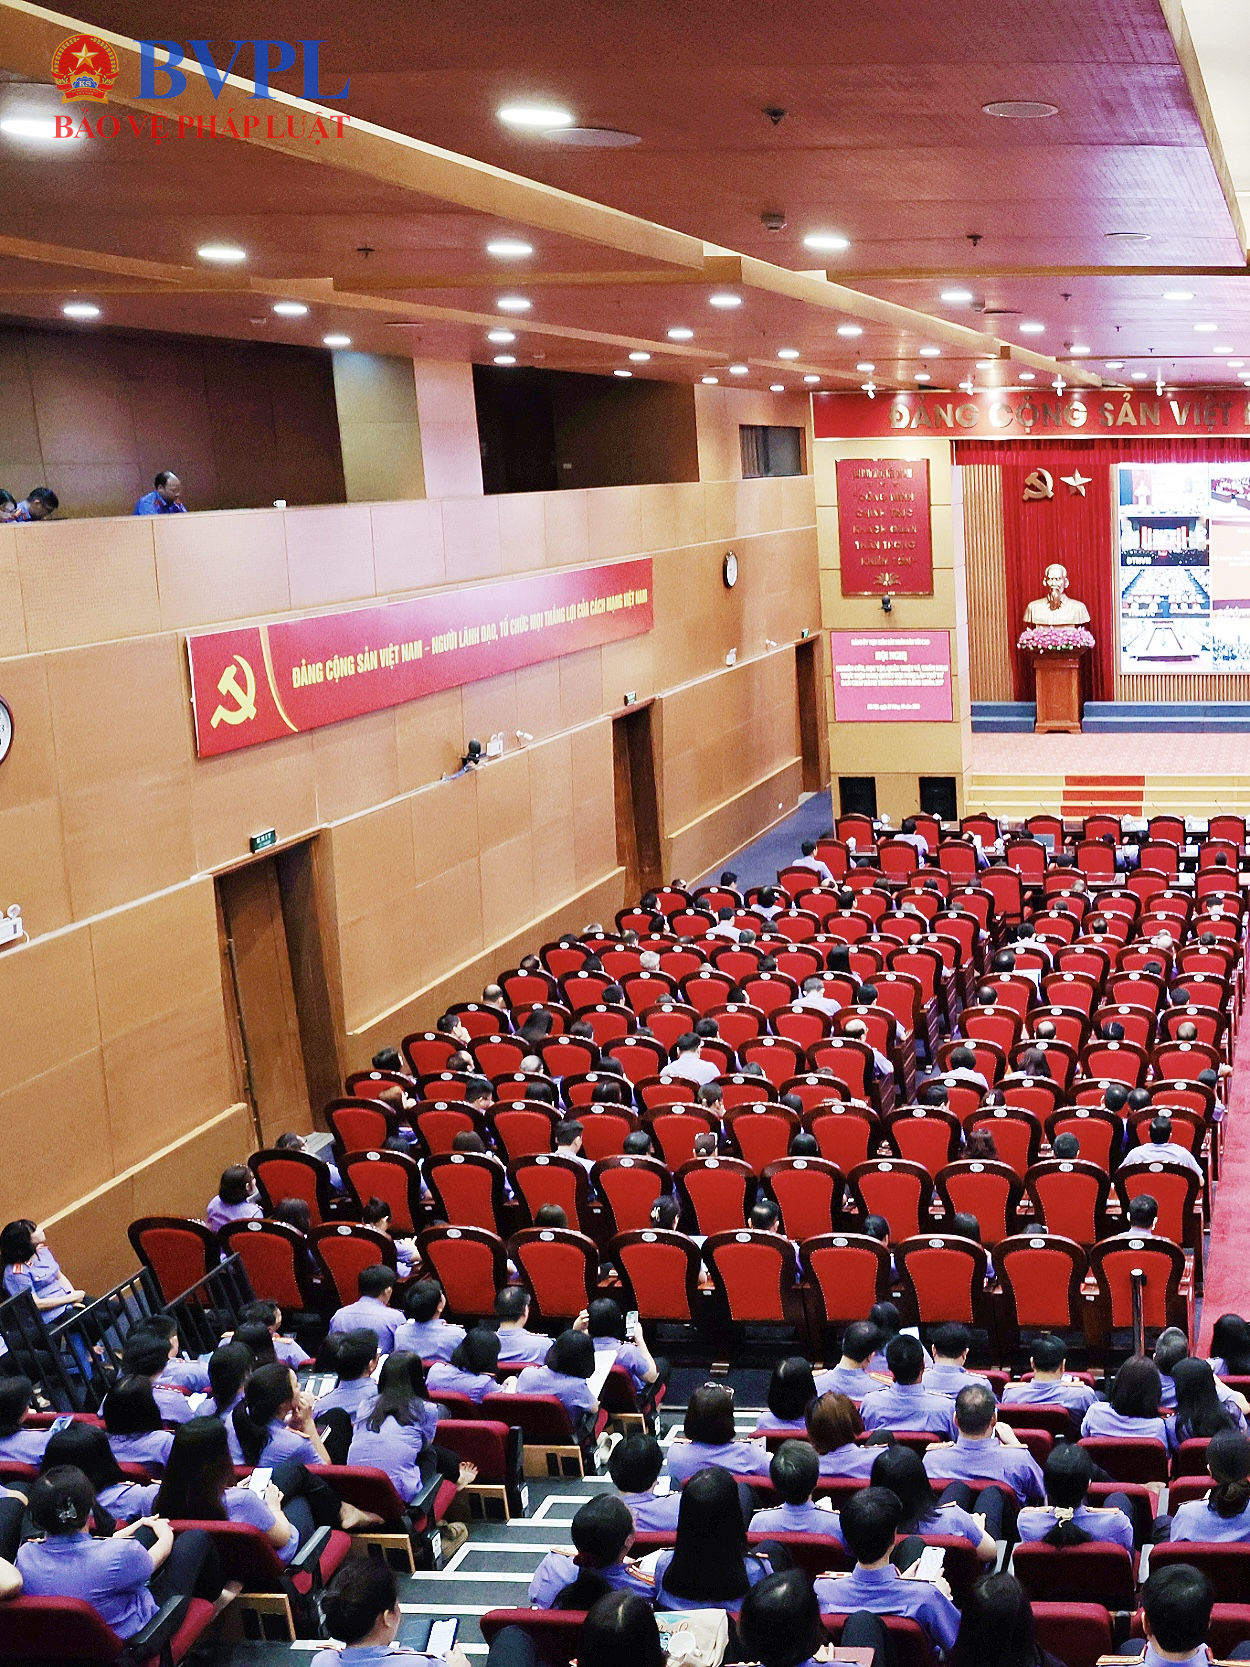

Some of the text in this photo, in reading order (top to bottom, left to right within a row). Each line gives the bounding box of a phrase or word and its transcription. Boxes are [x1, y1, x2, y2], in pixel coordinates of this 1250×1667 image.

[890, 396, 979, 429] ĐẢNG
[988, 395, 1088, 434] CỘNG
[1098, 393, 1161, 429] SẢN
[1168, 394, 1232, 432] VIỆT
[292, 658, 324, 688] ĐẢNG
[325, 654, 355, 683] CỘNG
[357, 646, 378, 674] SẢN
[380, 643, 400, 670] VIỆT
[401, 640, 422, 662] NAM
[432, 628, 458, 655] NGƯỜI
[459, 626, 480, 648] LÃNH
[500, 613, 509, 638] TỔ
[510, 614, 529, 635] CHỨC
[530, 612, 544, 632] MỌI
[544, 604, 566, 626] THẮNG
[566, 603, 576, 624] LỢI
[577, 598, 589, 618] CỦA
[590, 596, 606, 616] CÁCH
[636, 588, 648, 605] NAM
[256, 832, 272, 844] EXIT
